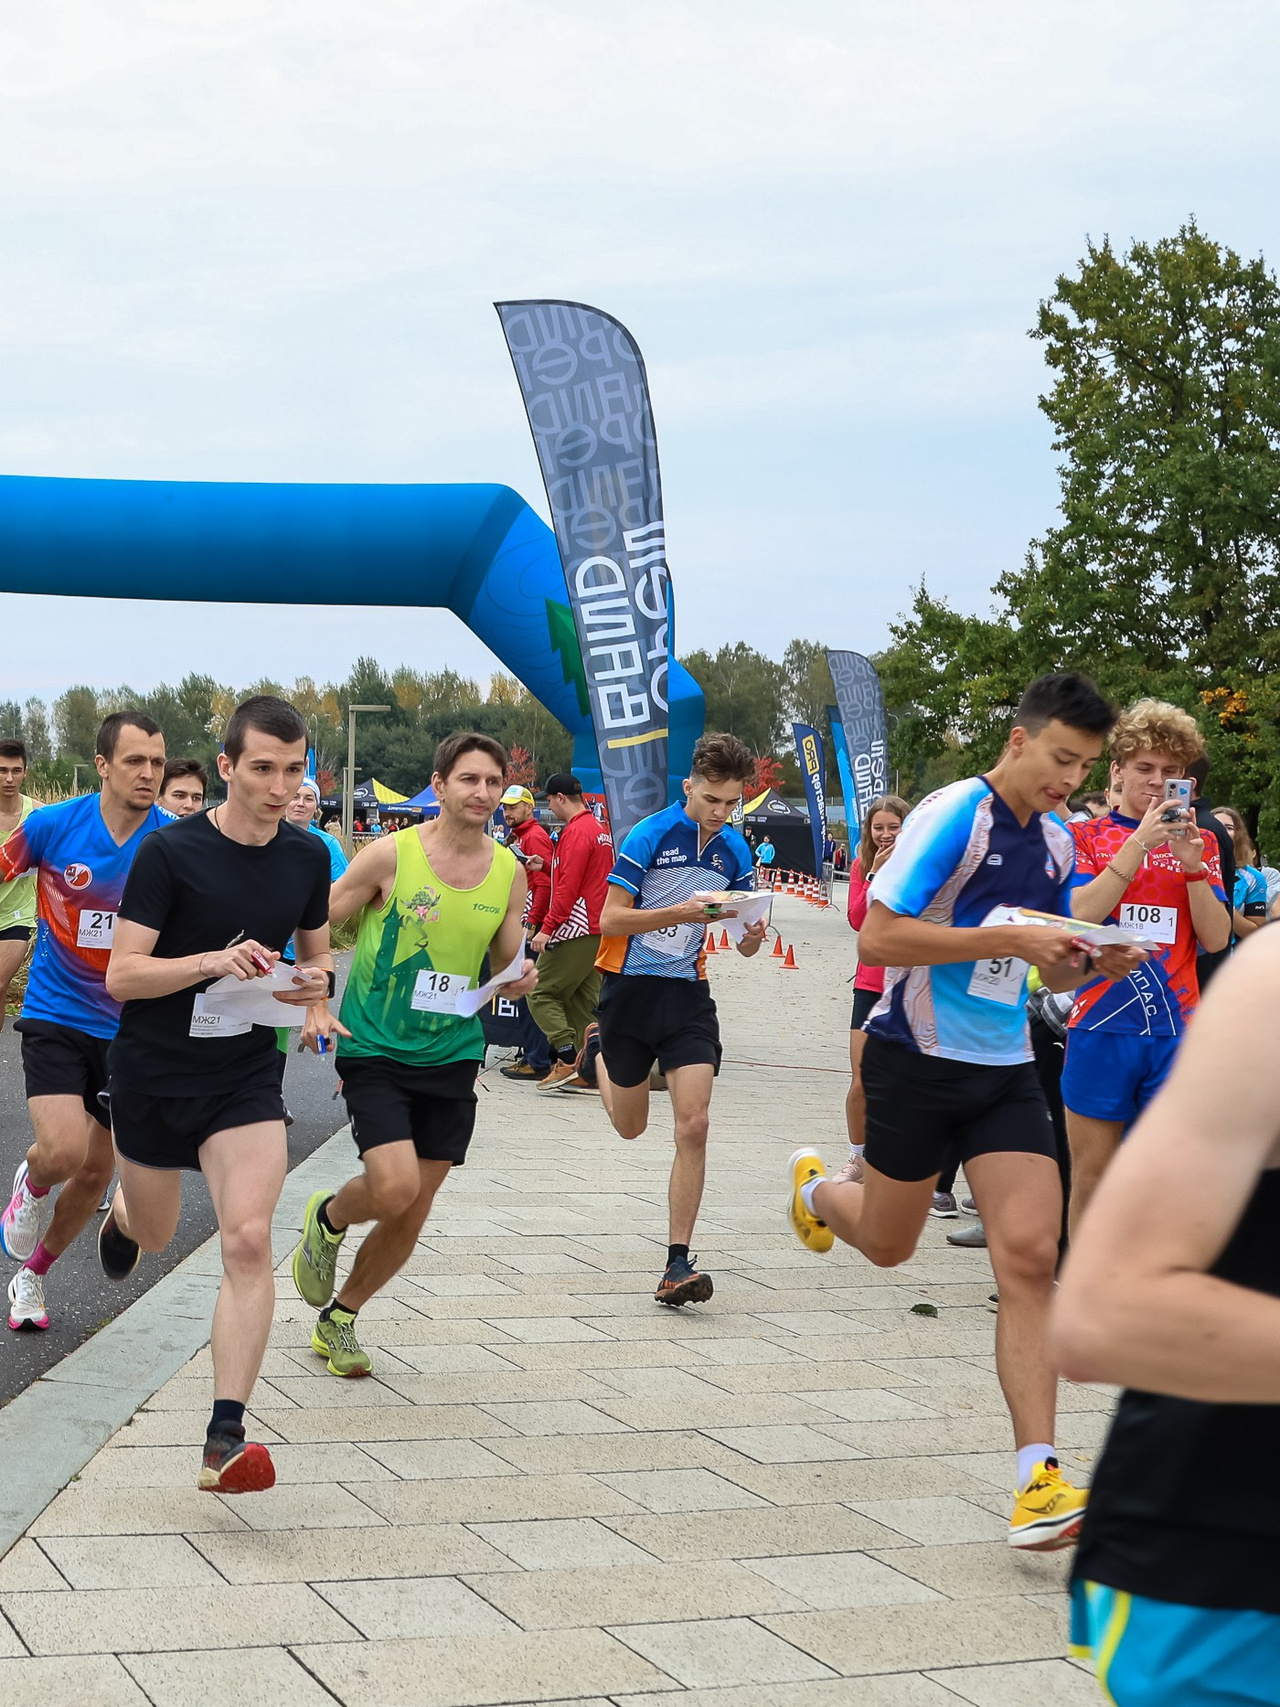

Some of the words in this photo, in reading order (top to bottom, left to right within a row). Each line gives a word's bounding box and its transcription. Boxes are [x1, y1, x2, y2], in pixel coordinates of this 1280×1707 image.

[662, 847, 679, 856] read
[656, 857, 670, 865] the
[671, 855, 687, 863] map
[90, 912, 113, 930] 21
[1126, 905, 1161, 923] 108
[1168, 917, 1173, 928] 1
[79, 929, 103, 937] МЖ21
[989, 957, 1014, 978] 51
[428, 973, 450, 992] 18
[192, 1015, 221, 1025] МЖ21
